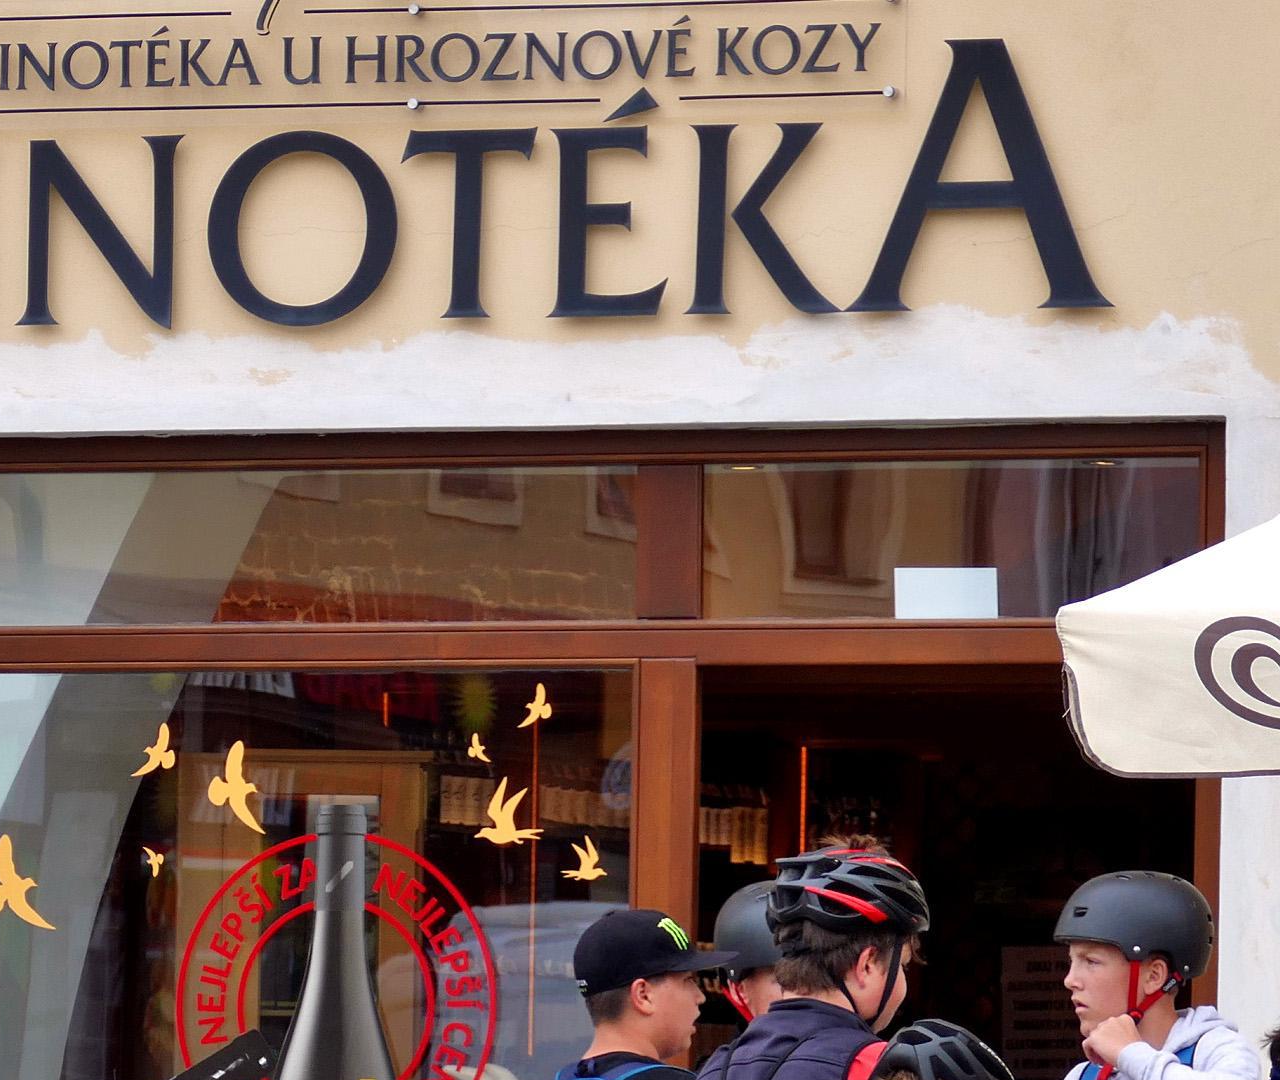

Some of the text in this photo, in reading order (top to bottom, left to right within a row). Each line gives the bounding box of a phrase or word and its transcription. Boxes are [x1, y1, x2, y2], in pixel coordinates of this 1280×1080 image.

[282, 36, 320, 84] U
[345, 16, 696, 83] HROZNOVÉ
[717, 22, 882, 74] KOZY
[197, 873, 274, 1045] NEJLEPŠÍ
[273, 857, 317, 900] ZA
[373, 863, 485, 1012] NEJLEPŠÍ
